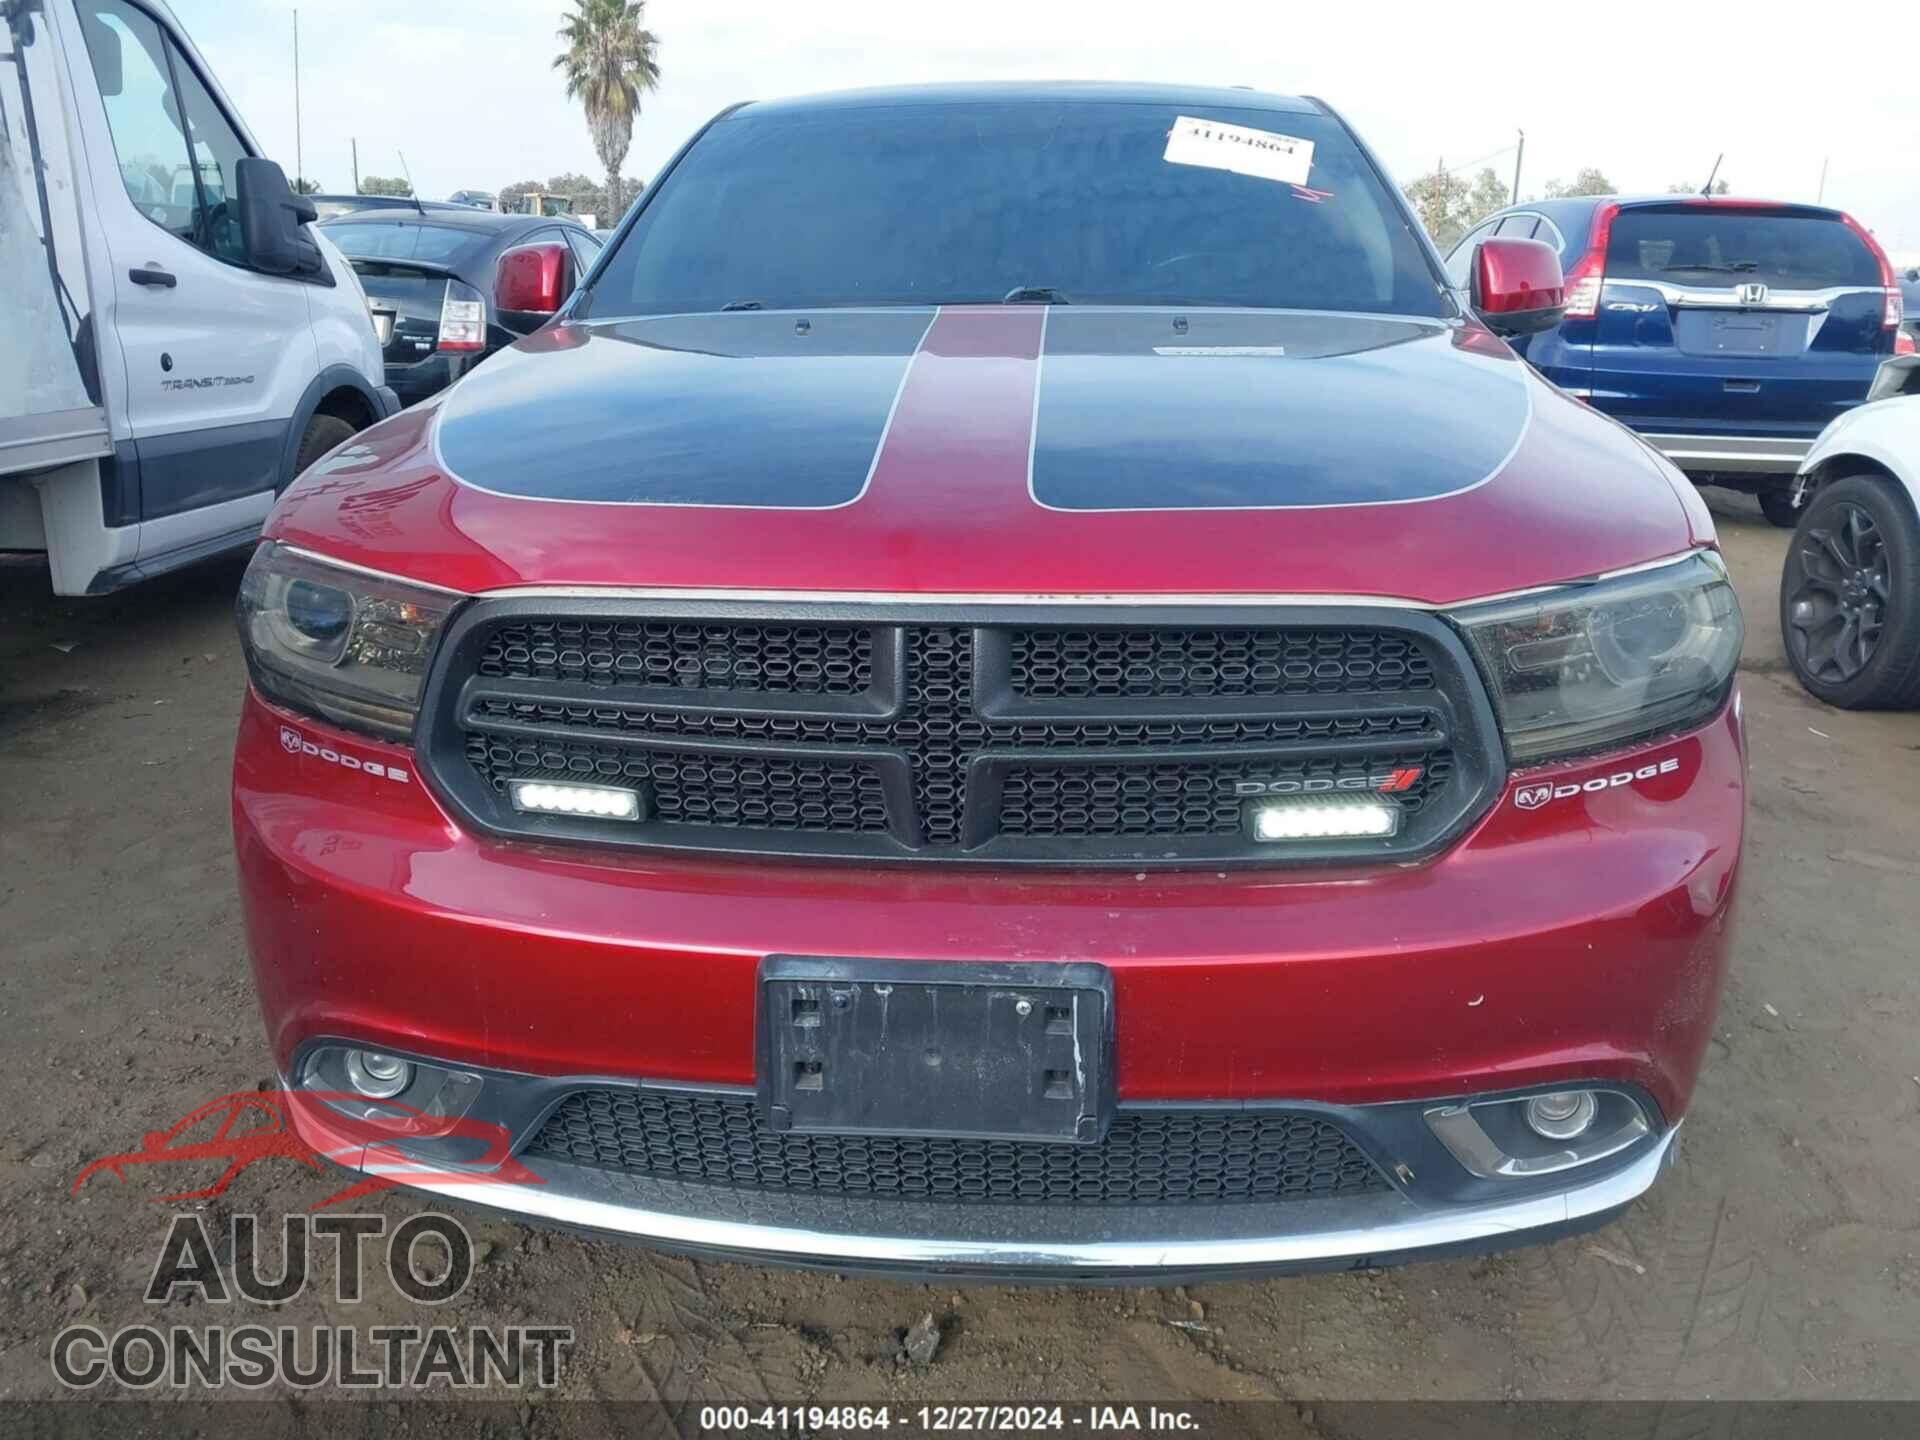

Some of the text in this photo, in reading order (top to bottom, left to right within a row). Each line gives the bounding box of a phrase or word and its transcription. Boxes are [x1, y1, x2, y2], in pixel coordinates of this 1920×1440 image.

[302, 741, 409, 783] DODGE
[1553, 757, 1680, 799] DODGE
[1235, 775, 1397, 794] DODGE
